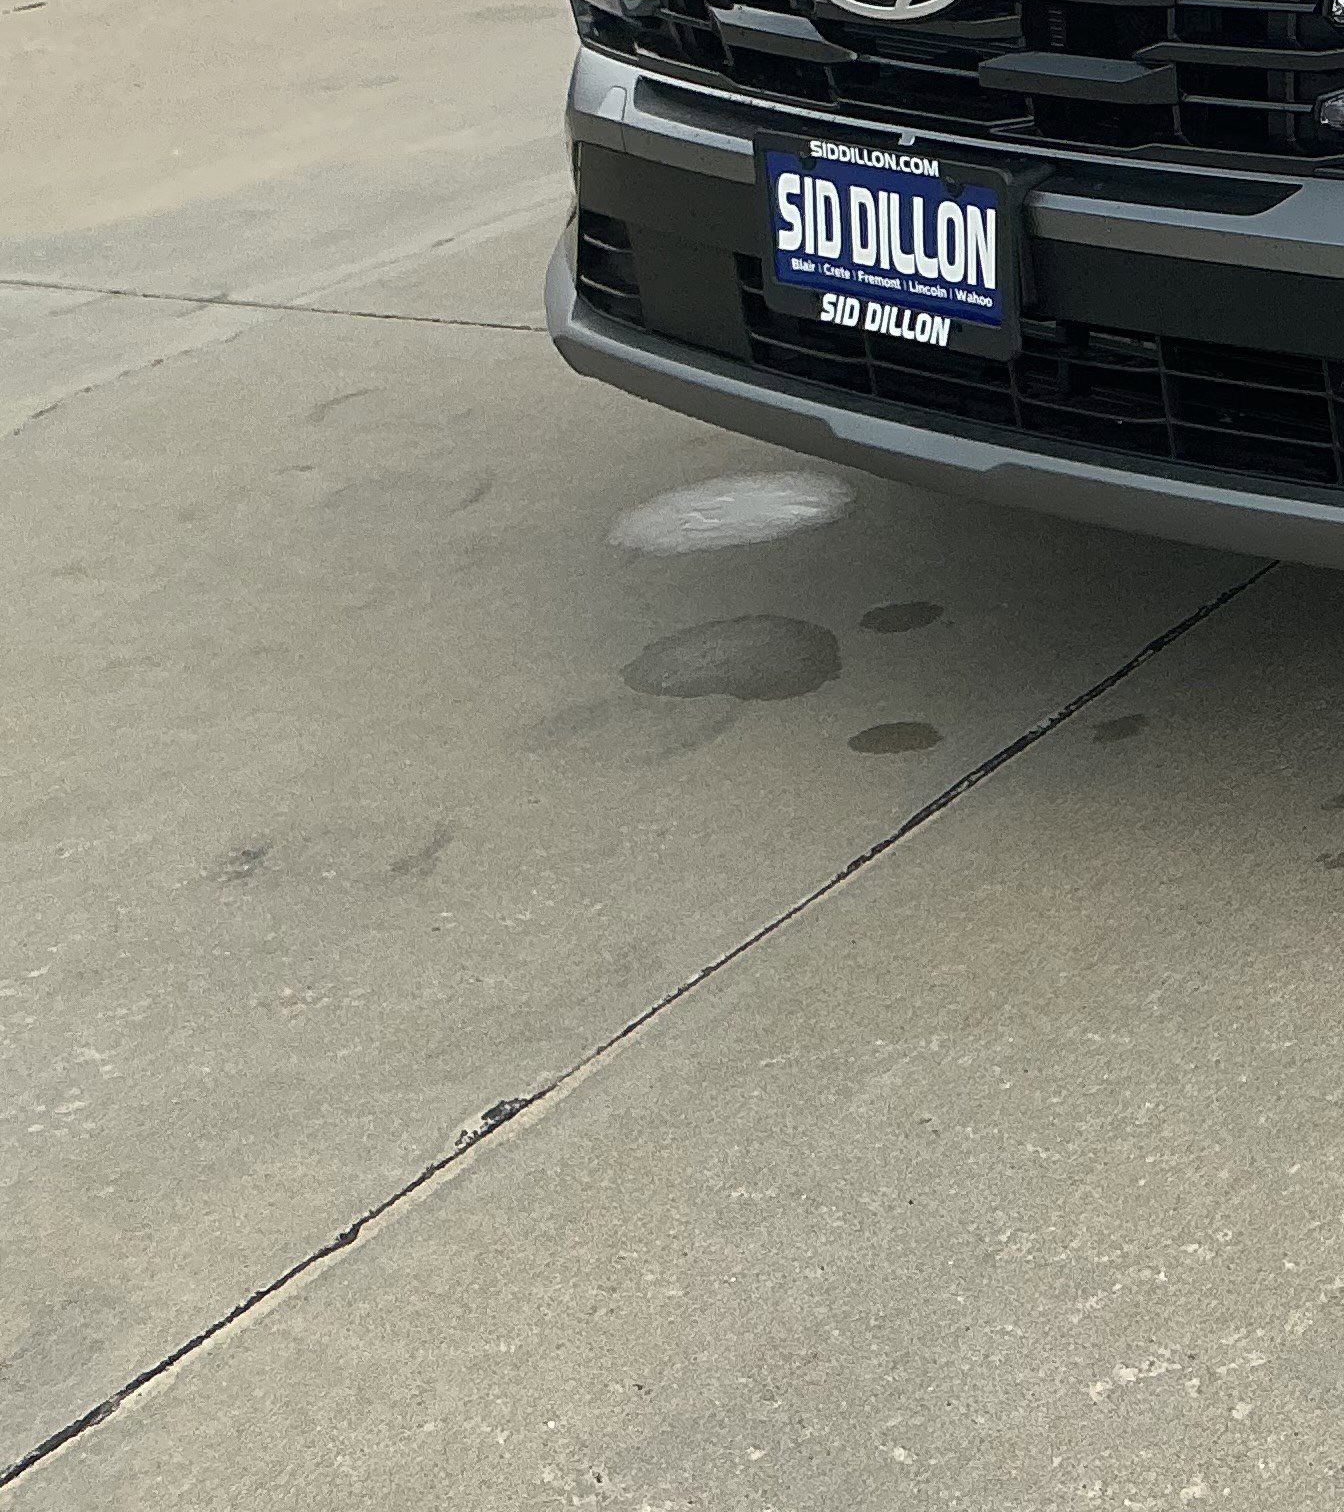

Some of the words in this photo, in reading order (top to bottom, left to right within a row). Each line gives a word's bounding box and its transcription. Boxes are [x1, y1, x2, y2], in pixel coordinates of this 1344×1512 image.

[809, 139, 941, 178] SIDDILLON.COM
[777, 172, 843, 260] SID
[850, 184, 997, 290] DILLON
[790, 257, 816, 273] Blair
[823, 263, 851, 280] Crete
[857, 270, 902, 291] Fremont
[909, 280, 948, 299] Lincoln
[955, 288, 994, 308] Wahoo
[820, 292, 860, 328] SID
[864, 301, 951, 348] DILLON
